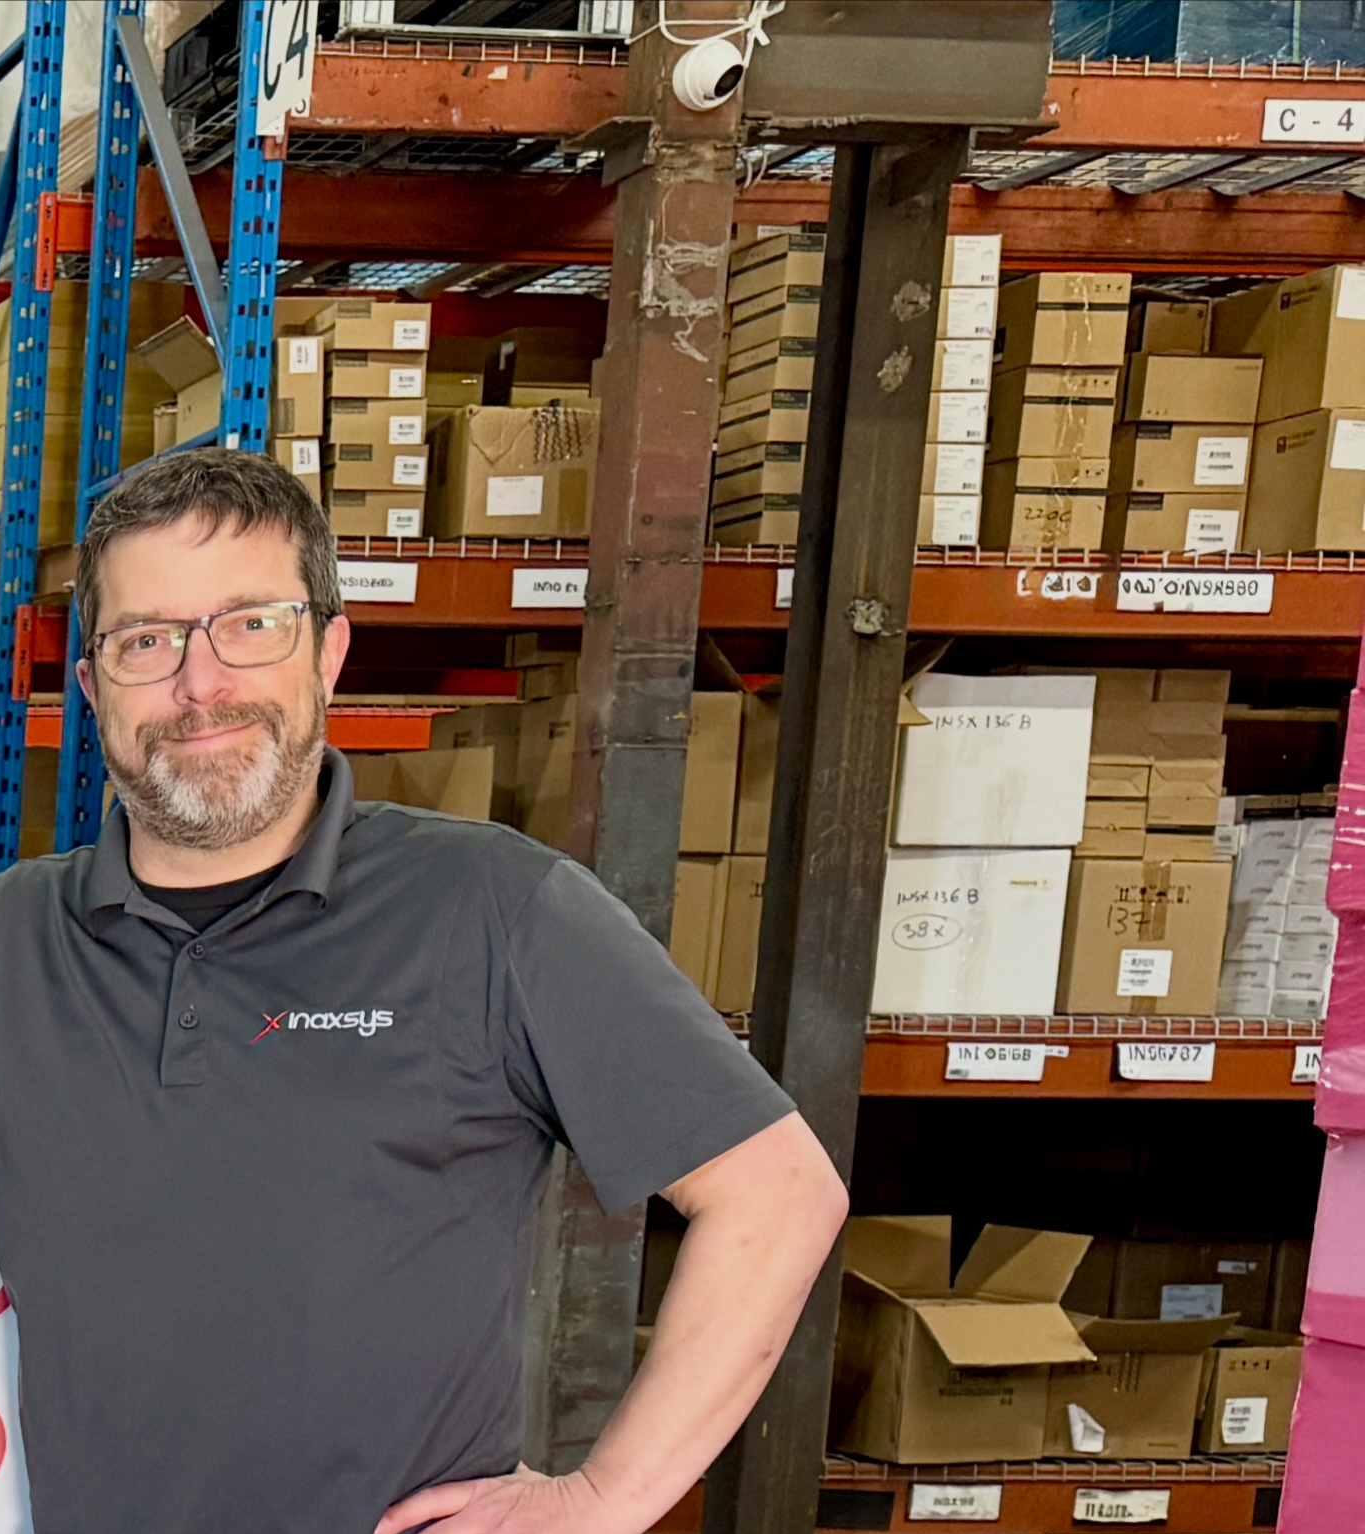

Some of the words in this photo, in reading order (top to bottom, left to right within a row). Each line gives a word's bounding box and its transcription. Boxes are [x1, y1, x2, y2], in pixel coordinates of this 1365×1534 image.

[1278, 108, 1295, 133] C
[1336, 107, 1354, 132] 4
[986, 713, 1015, 729] 136
[1020, 714, 1031, 730] B
[934, 888, 961, 903] 136
[967, 888, 979, 904] B
[1107, 904, 1151, 936] 137
[288, 1009, 394, 1037] inaxsys
